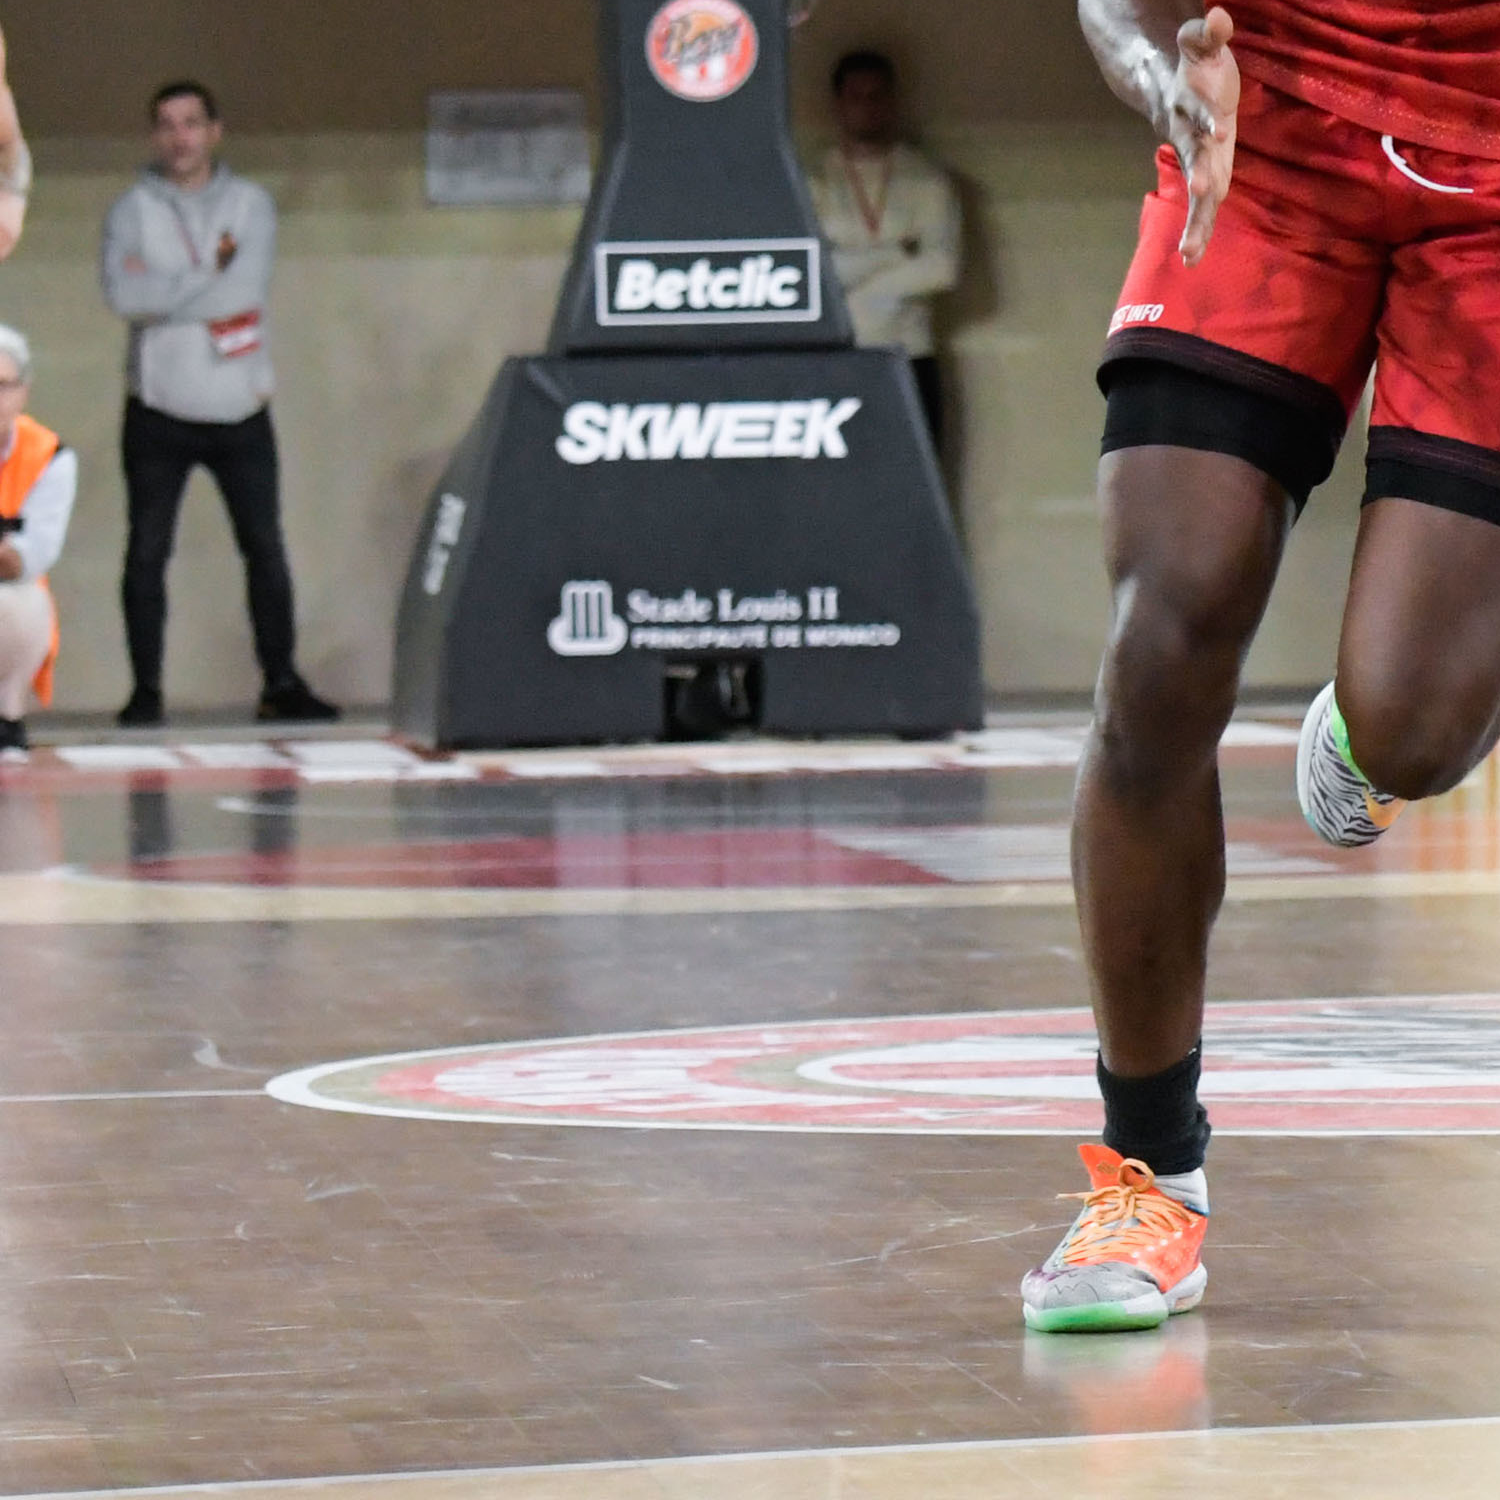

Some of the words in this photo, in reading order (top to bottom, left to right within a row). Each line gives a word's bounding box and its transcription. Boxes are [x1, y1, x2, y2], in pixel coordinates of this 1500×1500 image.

[614, 255, 802, 312] Betclic
[555, 398, 863, 465] SKWEEK
[627, 587, 714, 624] Stade
[717, 587, 803, 623] Louis
[807, 586, 840, 622] II
